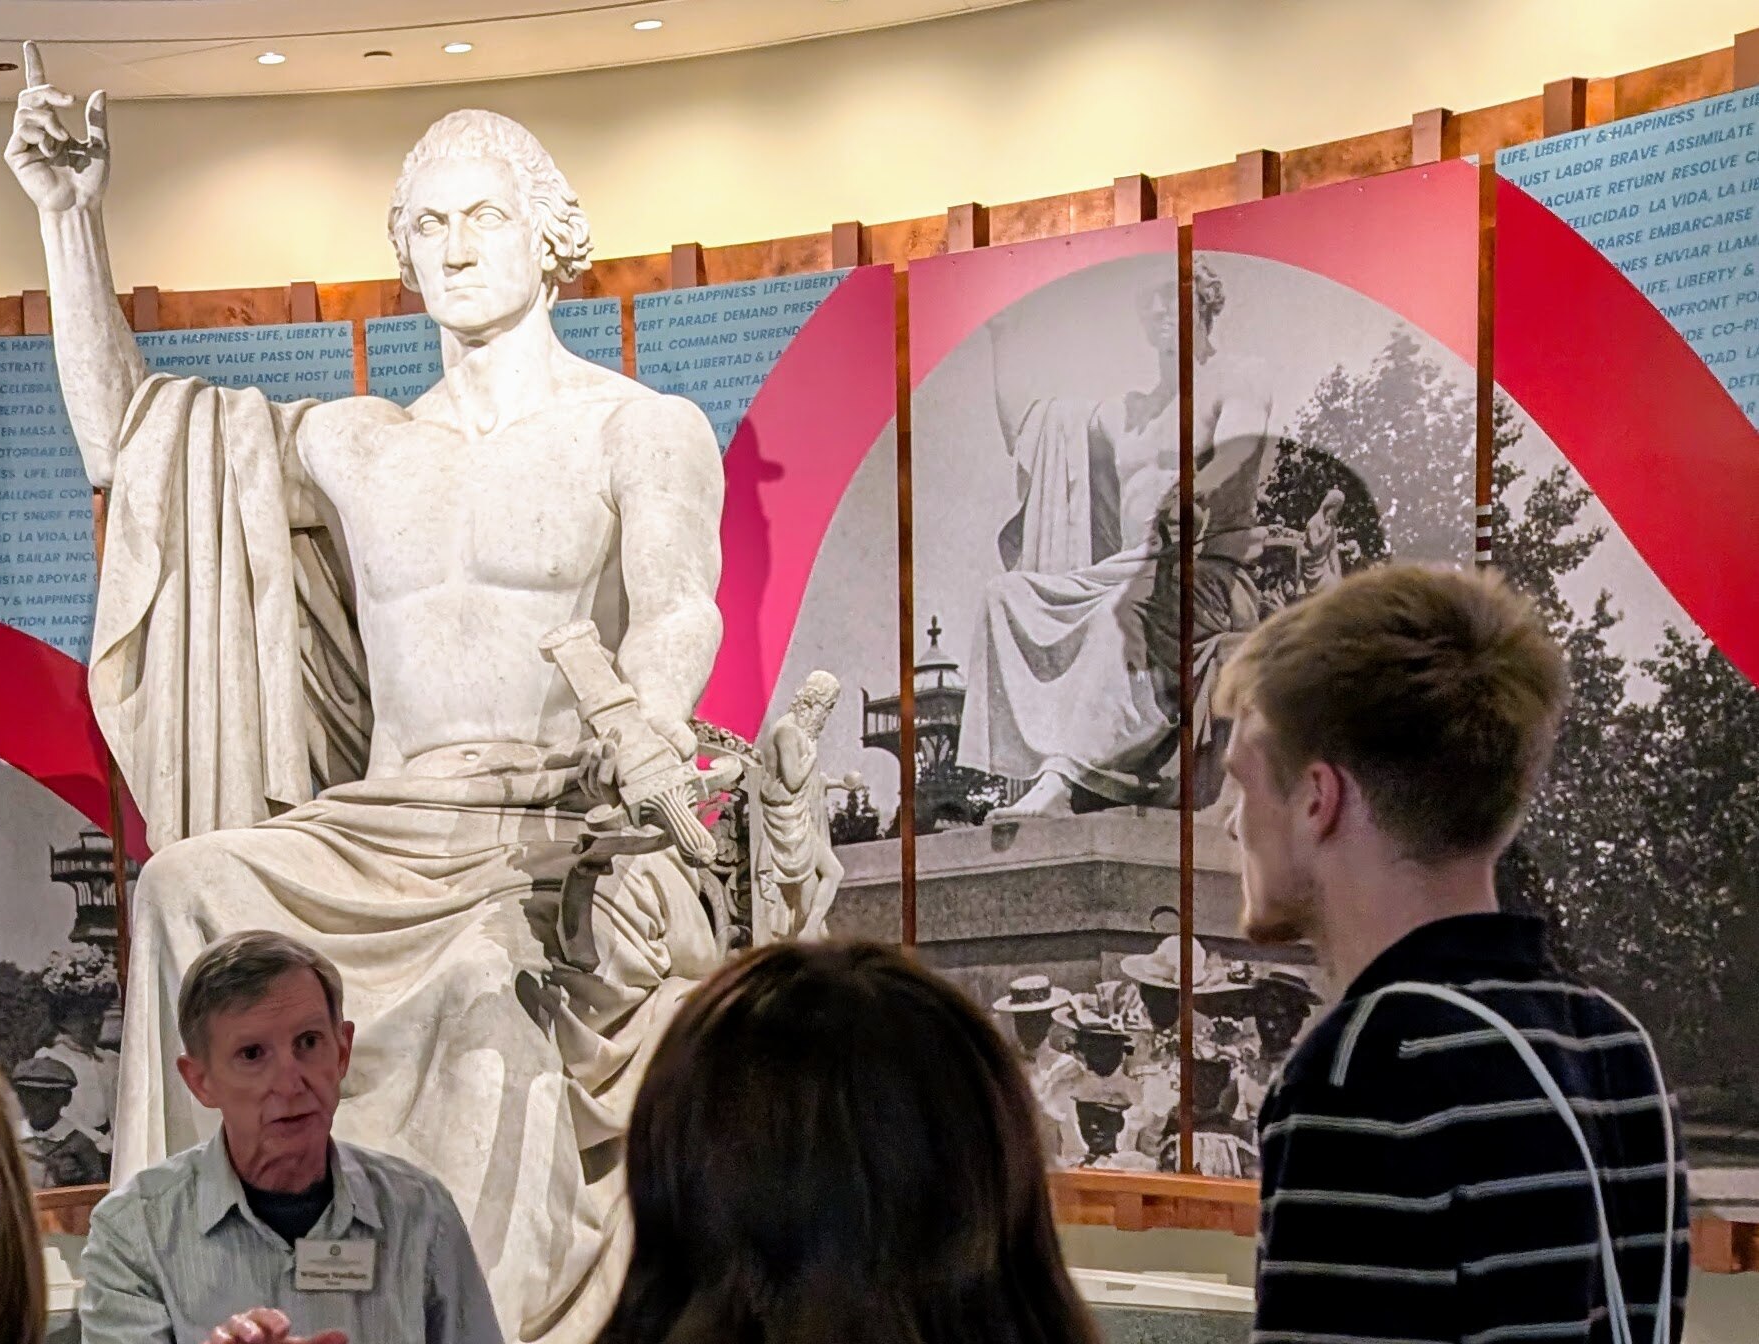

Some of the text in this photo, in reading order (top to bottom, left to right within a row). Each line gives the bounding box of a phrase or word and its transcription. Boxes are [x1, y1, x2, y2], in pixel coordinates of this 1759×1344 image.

[1501, 149, 1530, 166] LIFE,
[1535, 134, 1590, 158] LIBERTY
[1596, 129, 1607, 143] &
[1612, 108, 1695, 138] HAPPINESS
[1704, 99, 1737, 118] LIFE,
[1556, 157, 1603, 180] LABOR
[1610, 144, 1658, 167] BRAVE
[1665, 122, 1754, 154] ASSIMILATE
[1608, 170, 1666, 195] RETURN
[1672, 154, 1737, 179] RESOLVE
[1649, 198, 1667, 214] LA
[1717, 183, 1735, 199] LA
[1649, 207, 1754, 240] EMBARCARSE
[1655, 244, 1711, 267] ENVIAR
[1677, 266, 1736, 289] LIBERTY
[1744, 263, 1755, 277] &
[674, 294, 683, 305] &
[688, 286, 756, 303] HAPPINESS
[794, 275, 841, 291] LIBERTY
[594, 303, 620, 315] LIFE,
[669, 313, 717, 328] PARADE
[723, 306, 778, 322] DEMAND
[169, 334, 178, 345] &
[182, 331, 249, 345] HAPPINESS
[287, 327, 335, 340] LIBERTY
[338, 327, 348, 338] &
[563, 326, 599, 339] PRINT
[368, 342, 418, 356] SURVIVE
[668, 333, 737, 350] COMMAND
[156, 355, 210, 367] IMPROVE
[217, 352, 255, 364] VALUE
[261, 351, 292, 363] PASS
[295, 350, 314, 361] ON
[639, 361, 672, 375] VIDA,
[676, 360, 690, 372] LA
[694, 354, 752, 370] LIBERTAD
[755, 351, 764, 363] &
[234, 373, 289, 385] BALANCE
[295, 371, 328, 383] HOST
[371, 363, 422, 377] EXPLORE
[385, 387, 398, 397] LA
[19, 531, 33, 543] LA
[74, 530, 88, 542] LA
[37, 573, 87, 585] APOYAR
[26, 593, 94, 605] HAPPINESS
